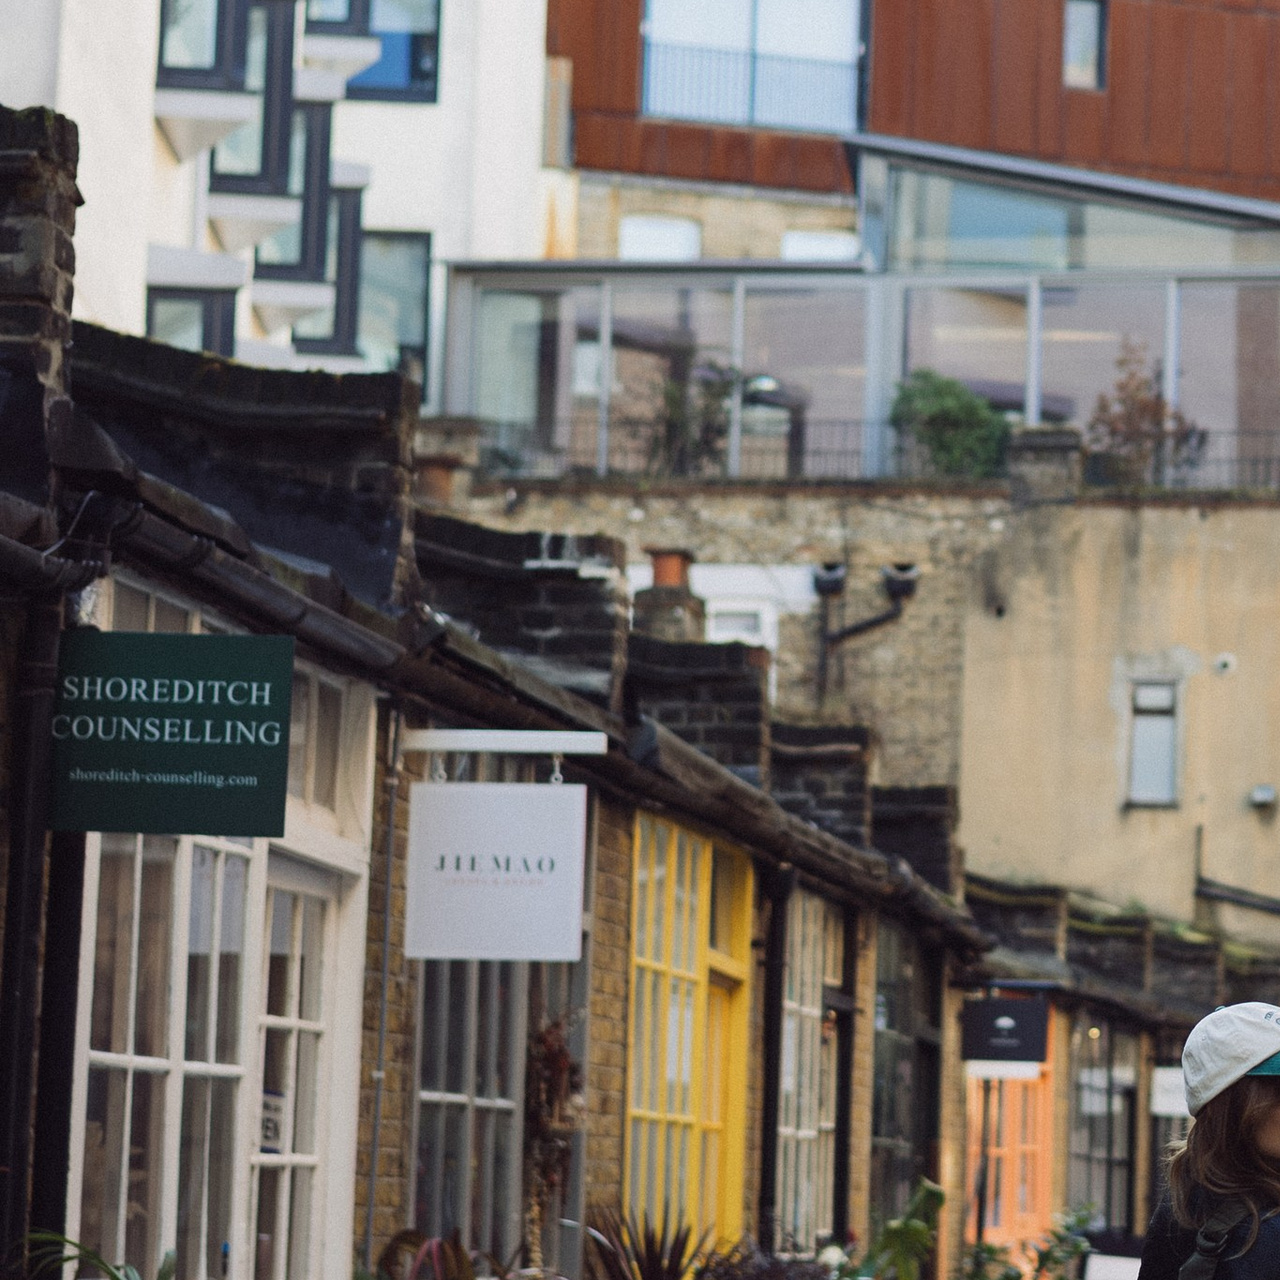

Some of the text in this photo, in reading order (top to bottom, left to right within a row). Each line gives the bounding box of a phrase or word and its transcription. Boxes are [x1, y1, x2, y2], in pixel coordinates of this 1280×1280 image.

[63, 675, 272, 706] SHOREDITCH
[51, 713, 281, 746] COUNSELLING
[69, 767, 258, 788] shoreditch-counselling.com
